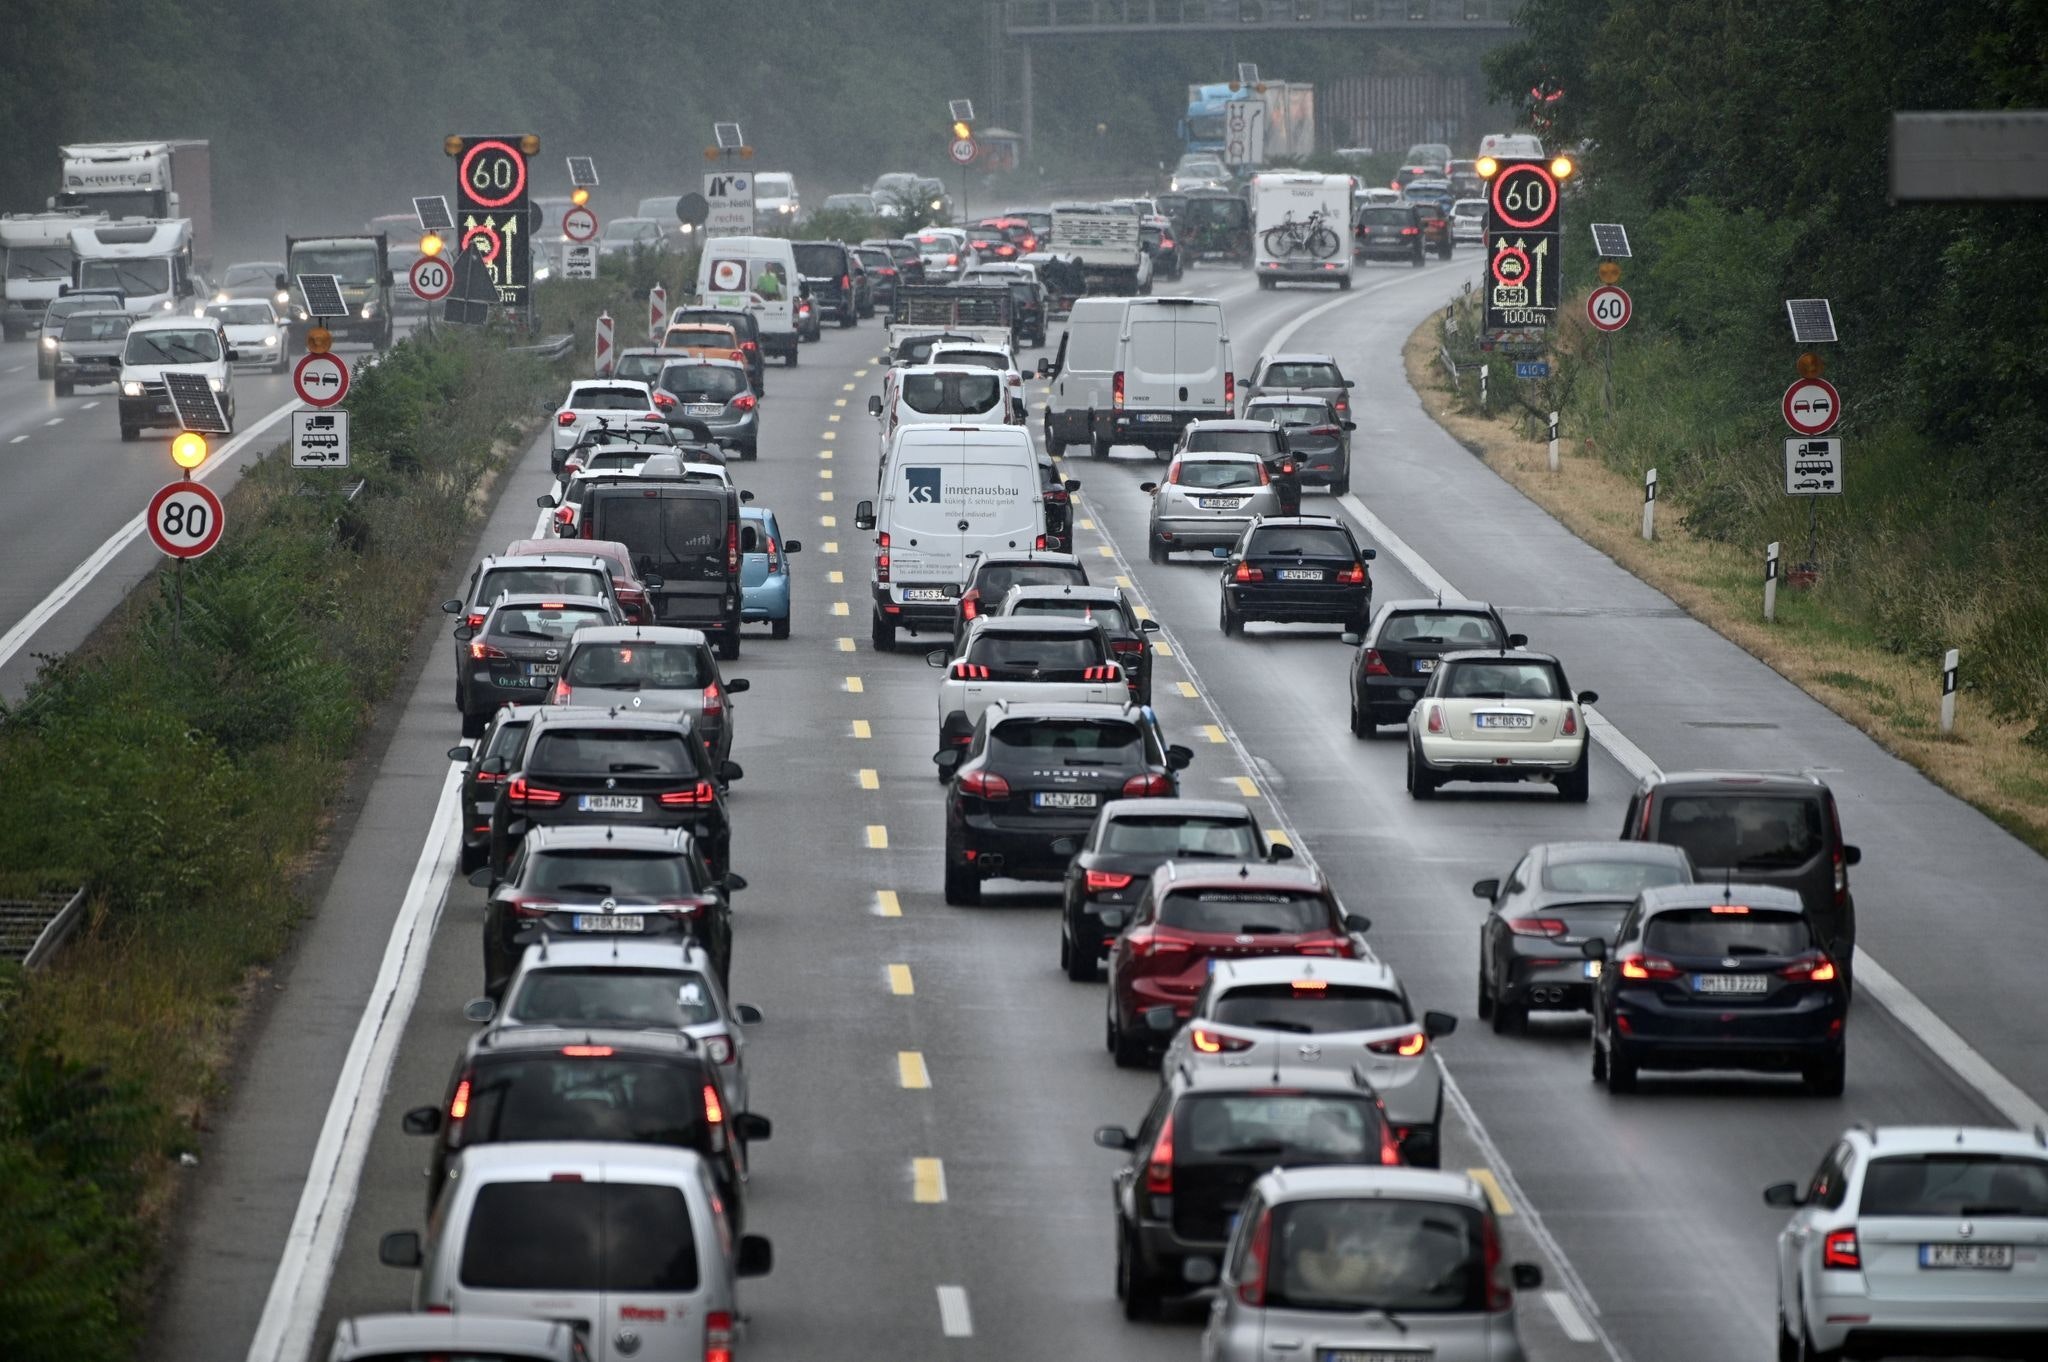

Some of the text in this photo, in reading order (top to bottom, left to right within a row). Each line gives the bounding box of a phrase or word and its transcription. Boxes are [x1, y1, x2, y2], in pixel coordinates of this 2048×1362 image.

[473, 158, 511, 188] 60
[1505, 180, 1542, 211] 60
[419, 267, 443, 287] 60
[1597, 298, 1622, 319] 60
[907, 486, 932, 504] KS
[945, 484, 1019, 496] innenausbau
[163, 502, 206, 538] 80
[924, 590, 934, 598] KS
[626, 798, 638, 808] 32
